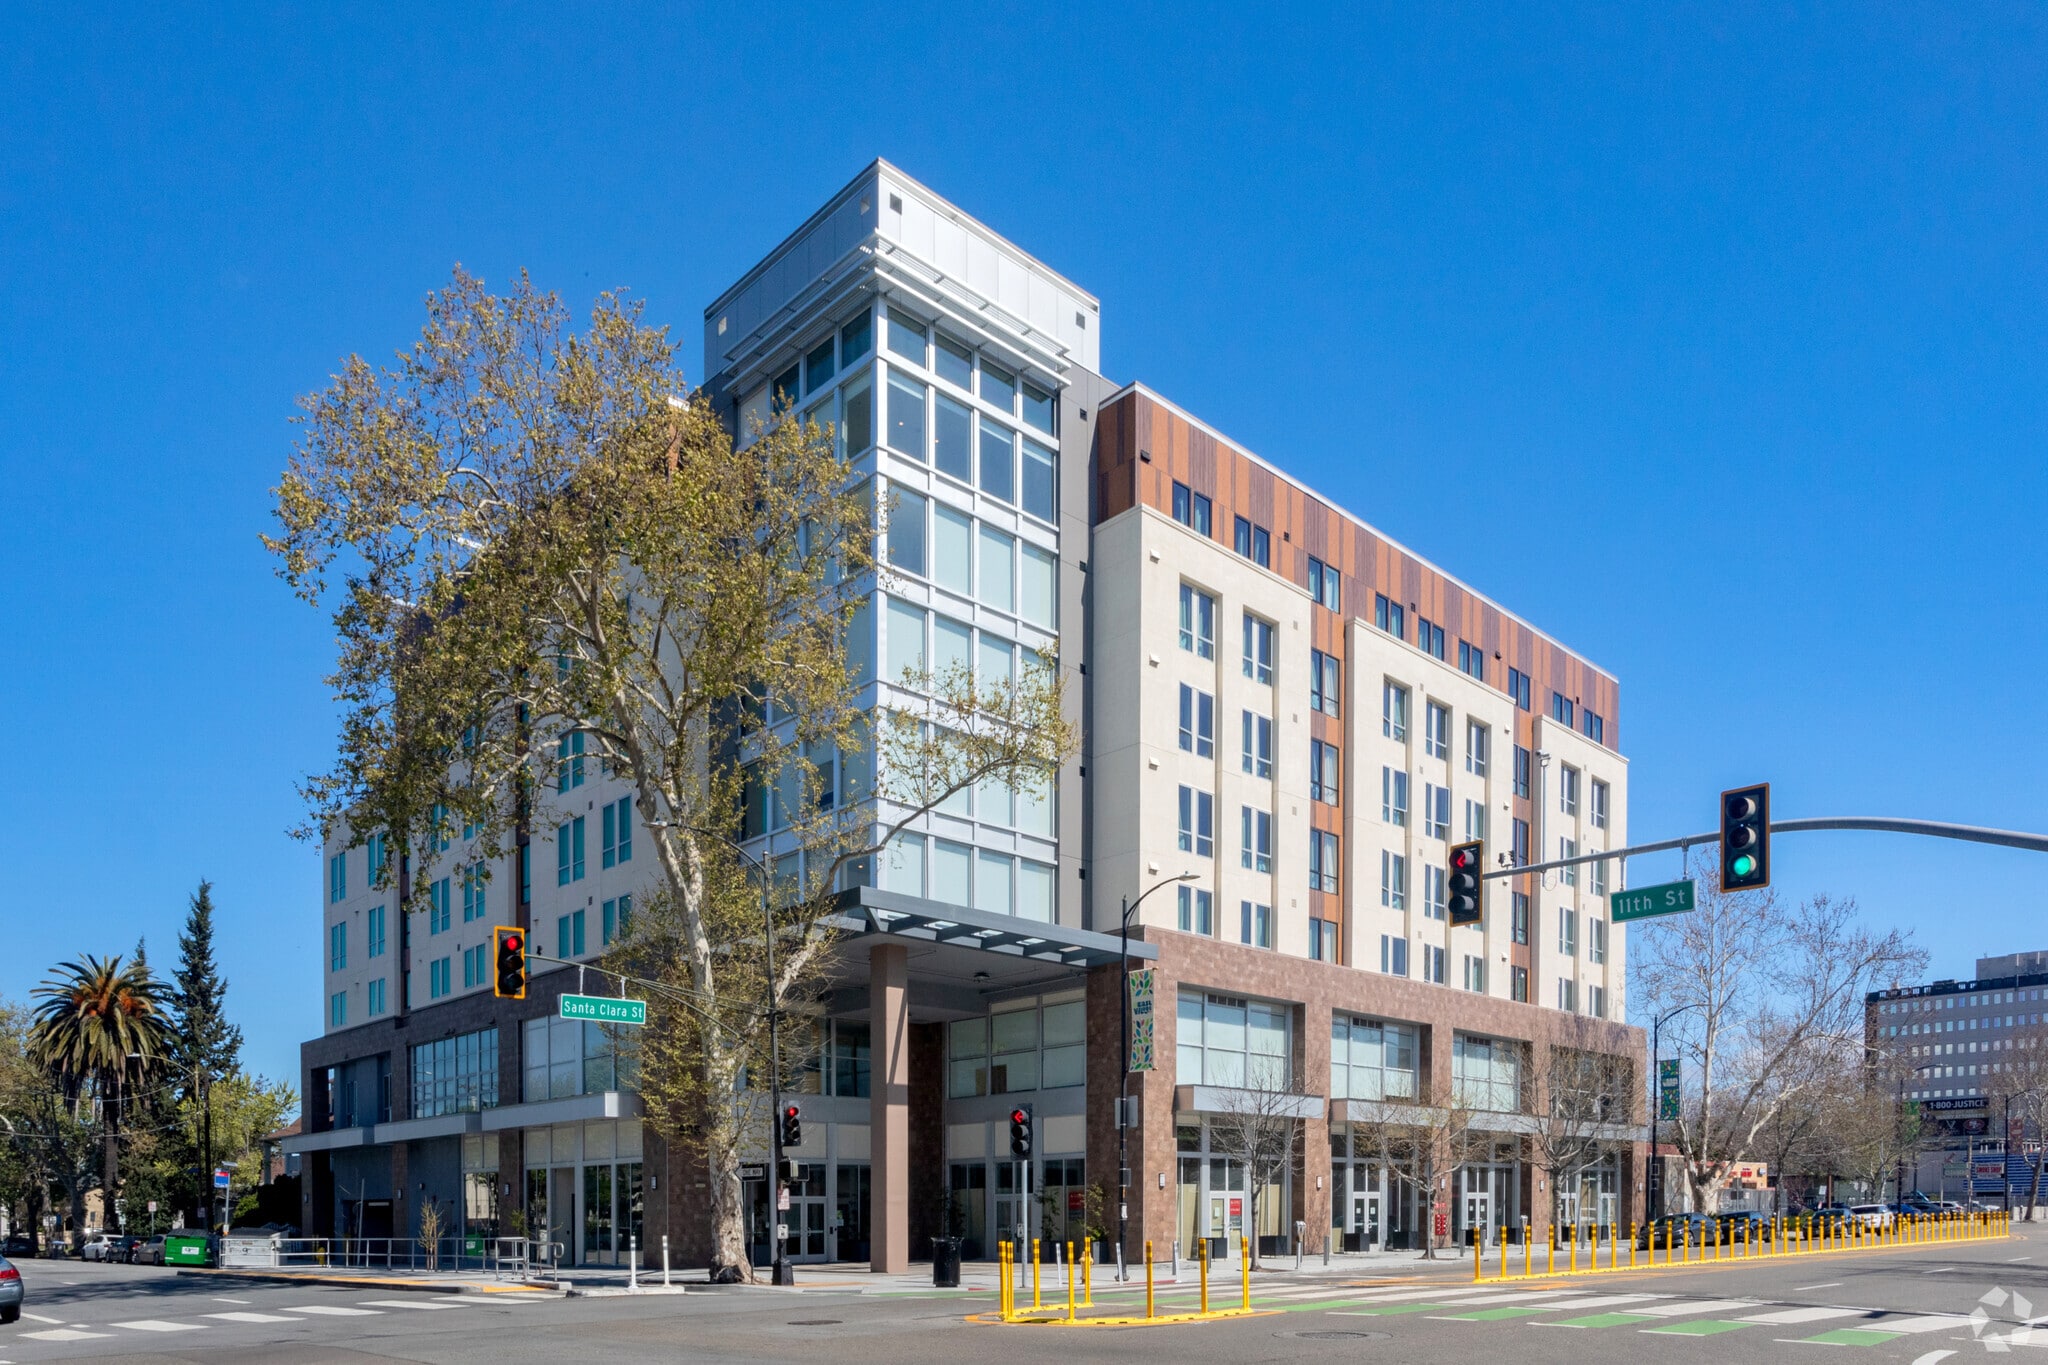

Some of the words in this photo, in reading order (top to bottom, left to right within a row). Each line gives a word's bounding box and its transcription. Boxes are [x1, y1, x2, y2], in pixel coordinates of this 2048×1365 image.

[1619, 895, 1652, 914] 11th
[1665, 889, 1686, 906] St
[564, 1001, 595, 1014] Santa
[600, 1004, 627, 1017] Clara
[631, 1007, 643, 1018] St
